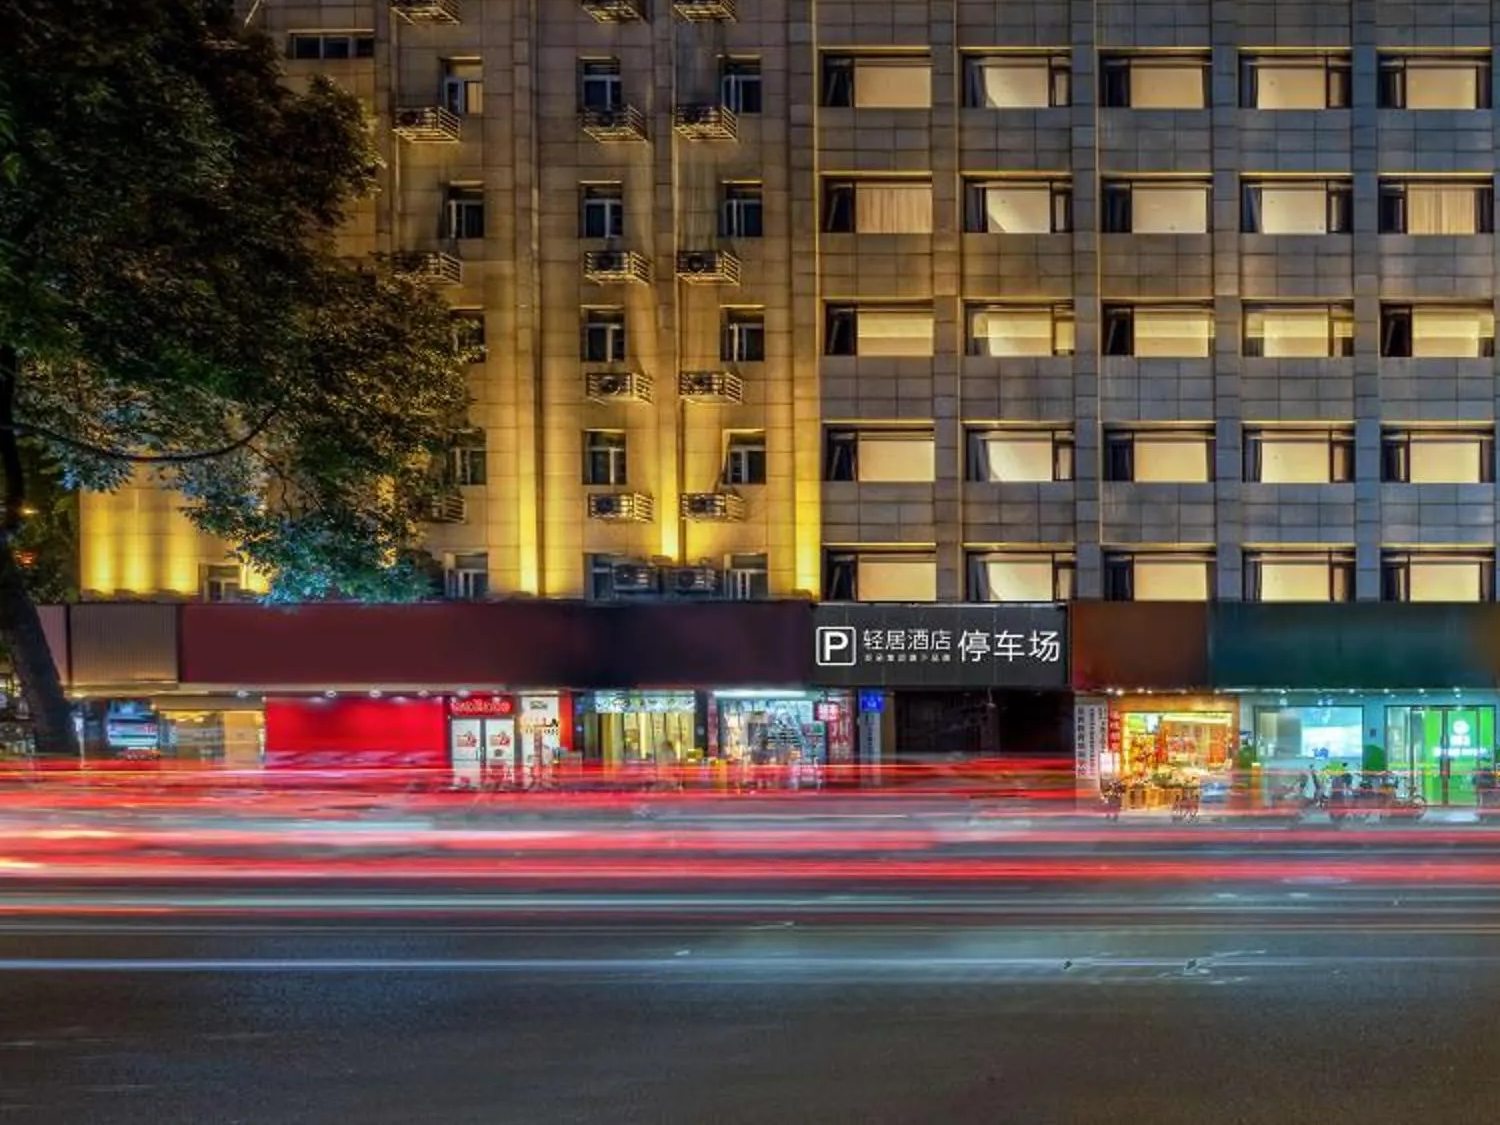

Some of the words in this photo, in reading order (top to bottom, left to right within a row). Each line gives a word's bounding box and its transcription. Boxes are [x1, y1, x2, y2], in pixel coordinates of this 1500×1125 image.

[824, 631, 848, 661] P
[863, 629, 952, 651] 轻居酒店
[958, 630, 1060, 662] 停车场
